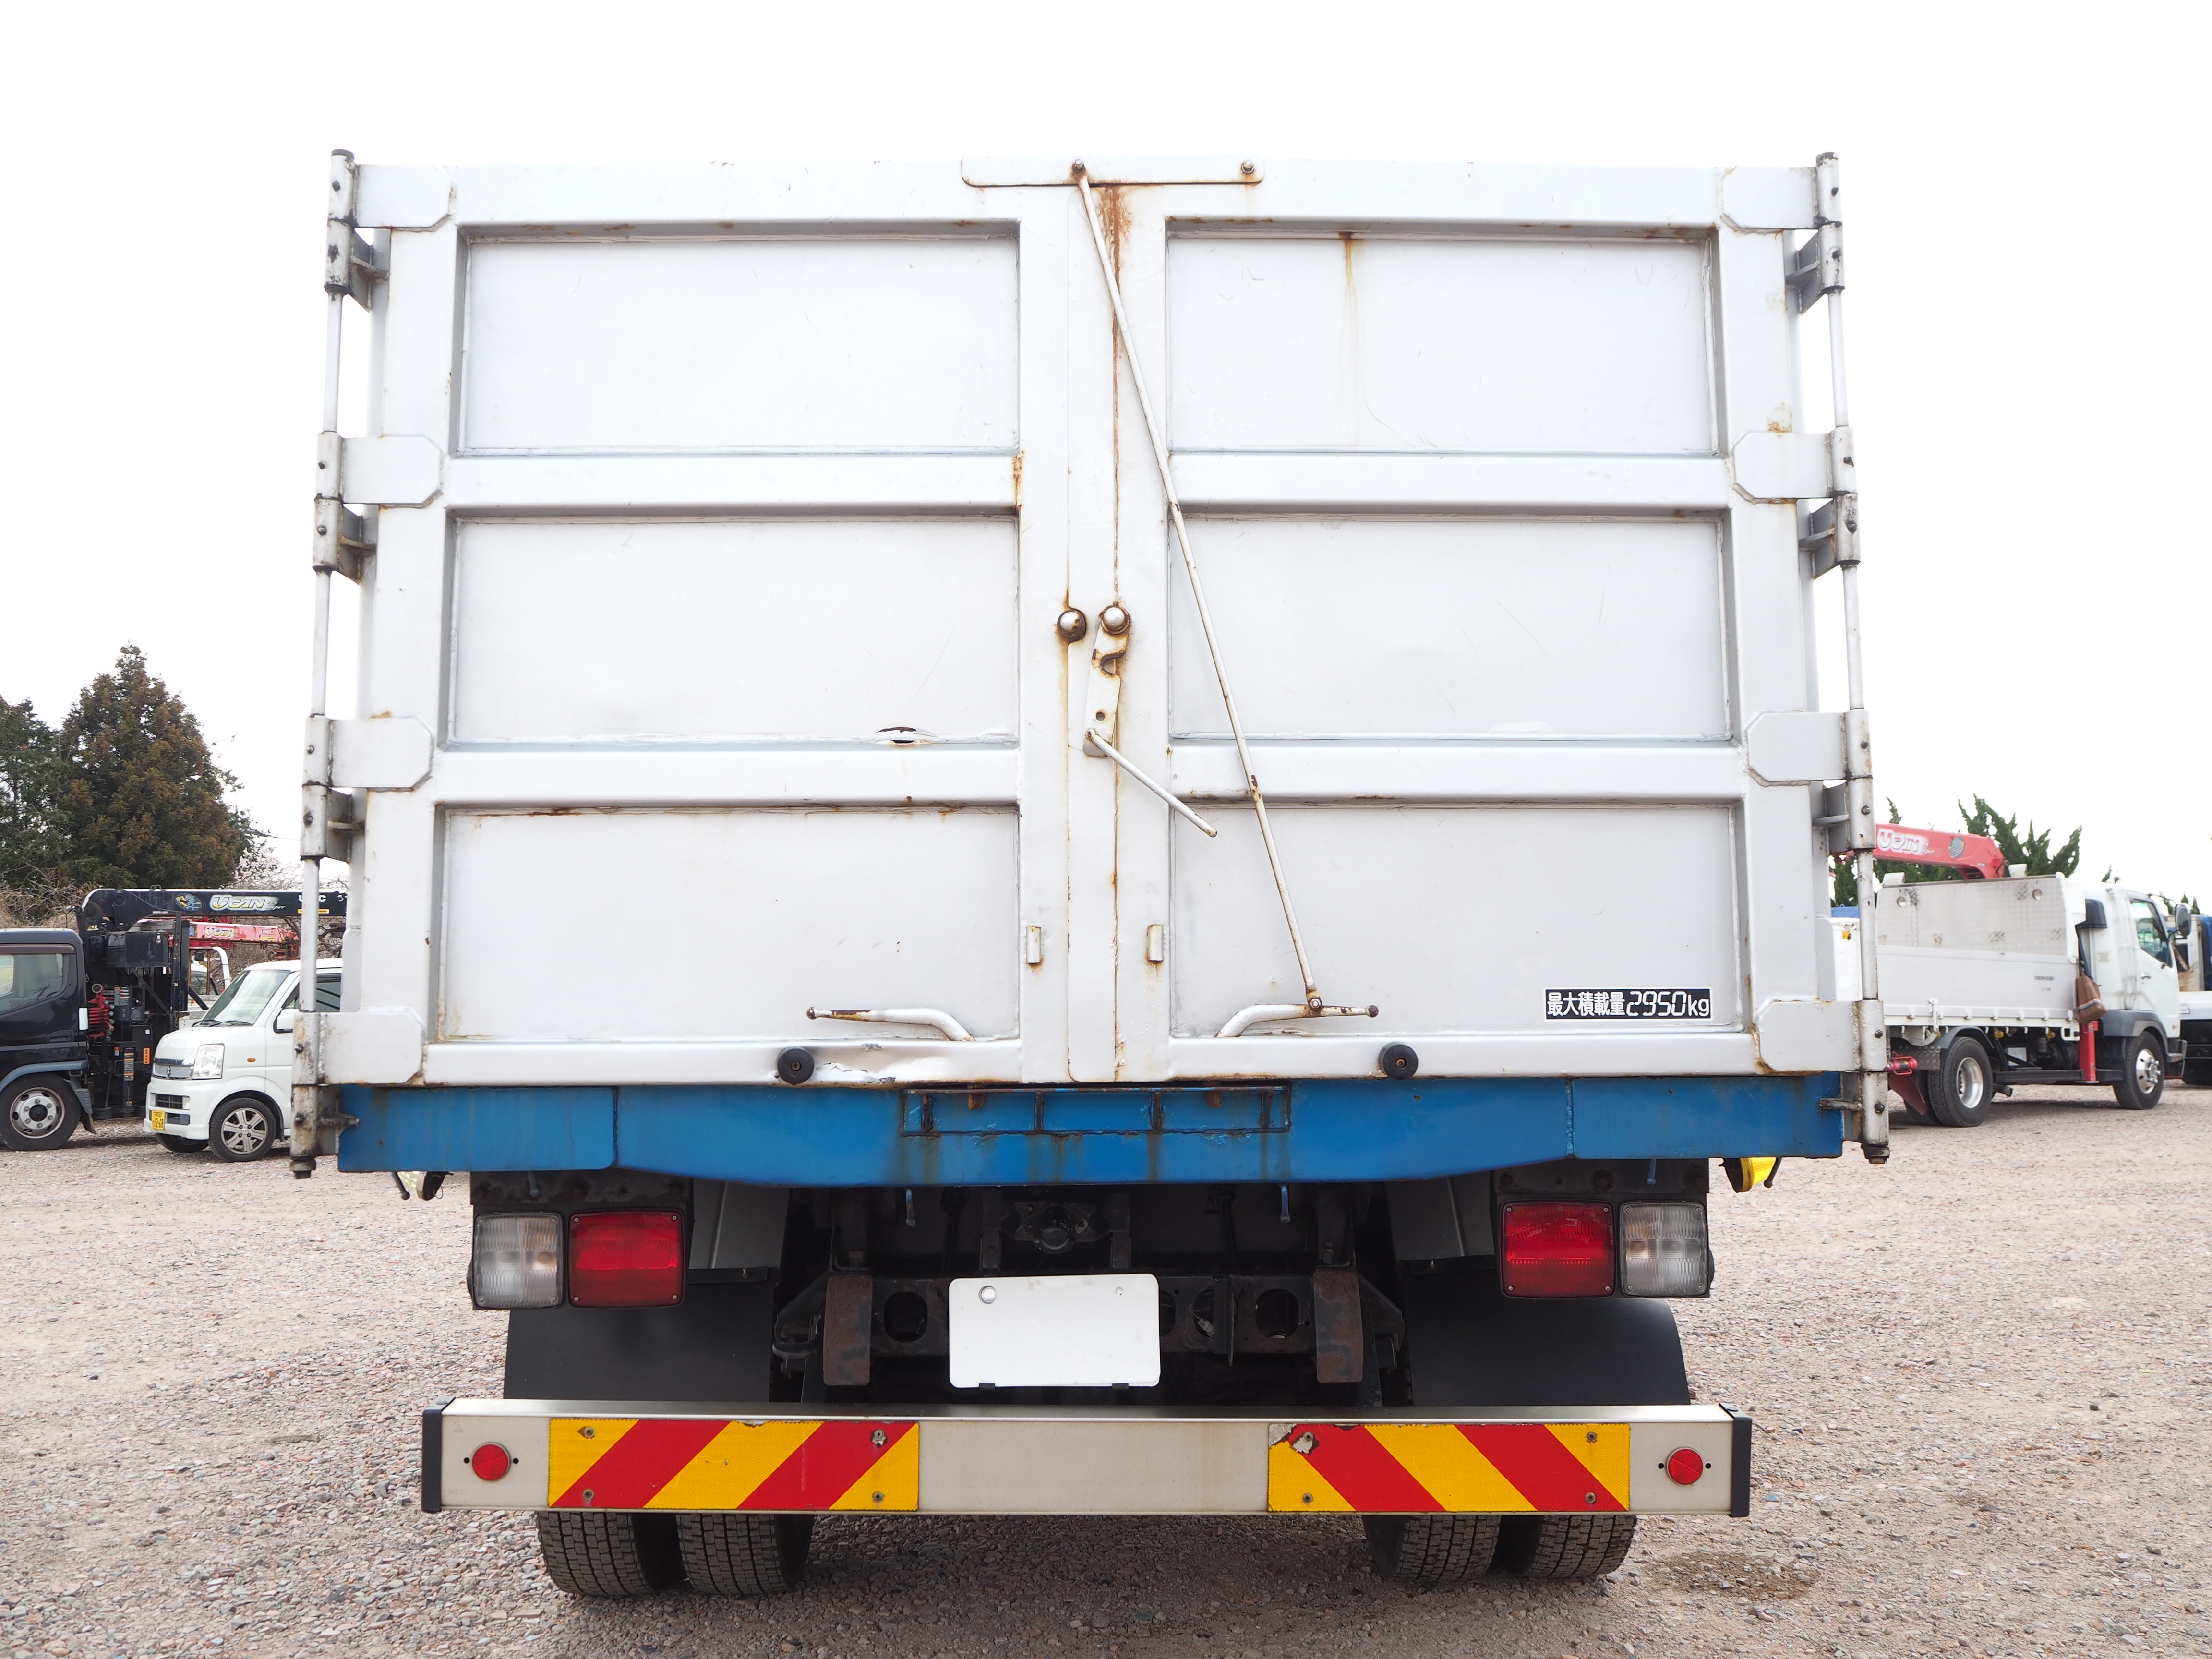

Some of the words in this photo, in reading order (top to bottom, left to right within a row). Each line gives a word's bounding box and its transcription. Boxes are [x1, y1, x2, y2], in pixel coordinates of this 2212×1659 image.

[1547, 991, 1710, 1017] 最大積載量2950kg
